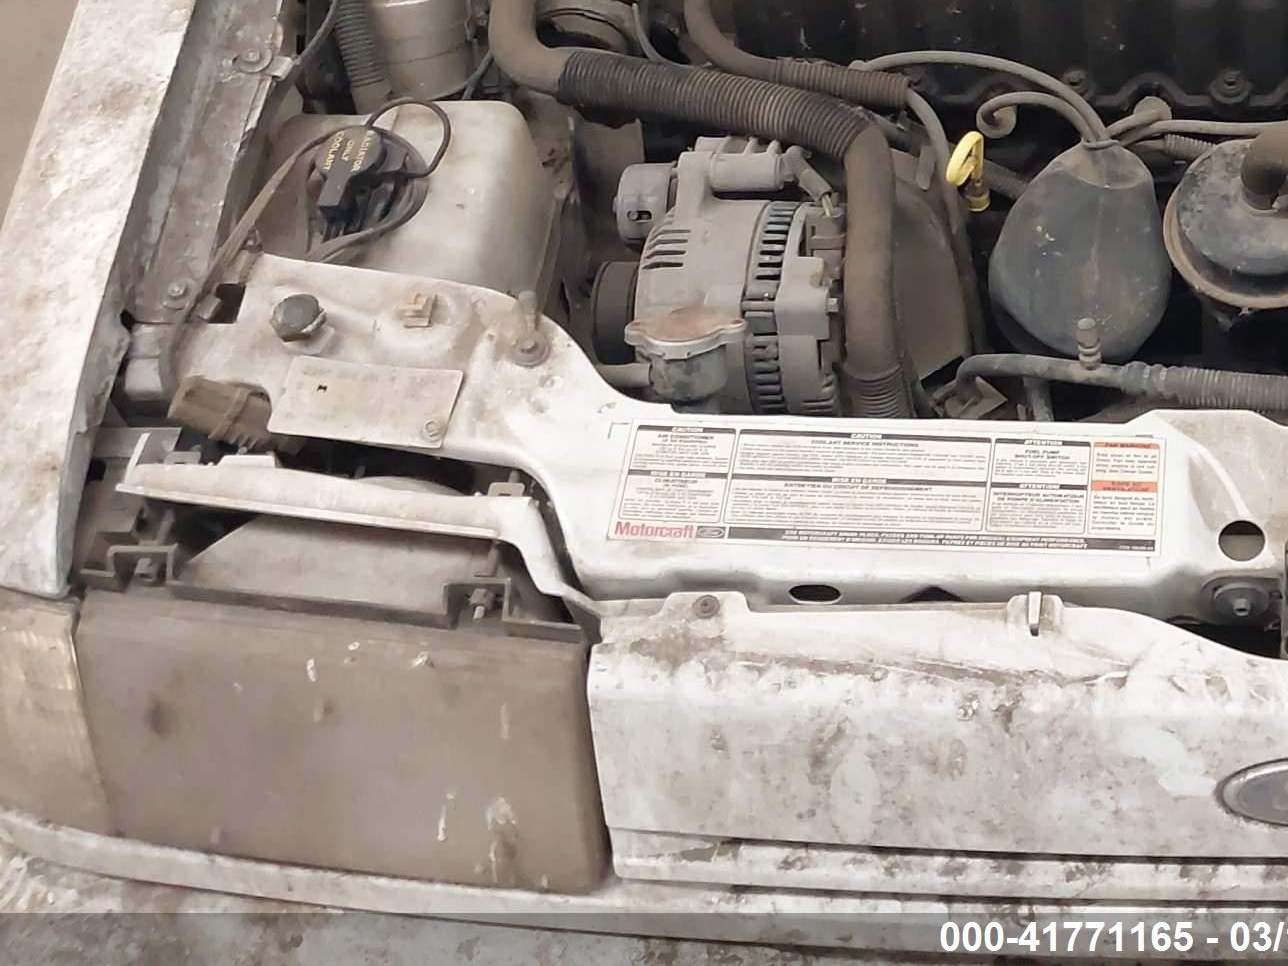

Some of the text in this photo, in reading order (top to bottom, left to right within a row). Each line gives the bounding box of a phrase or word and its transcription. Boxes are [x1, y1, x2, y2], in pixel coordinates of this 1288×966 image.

[323, 131, 345, 171] COOLANT
[341, 140, 354, 162] ONLY
[614, 521, 694, 538] Motorcraft
